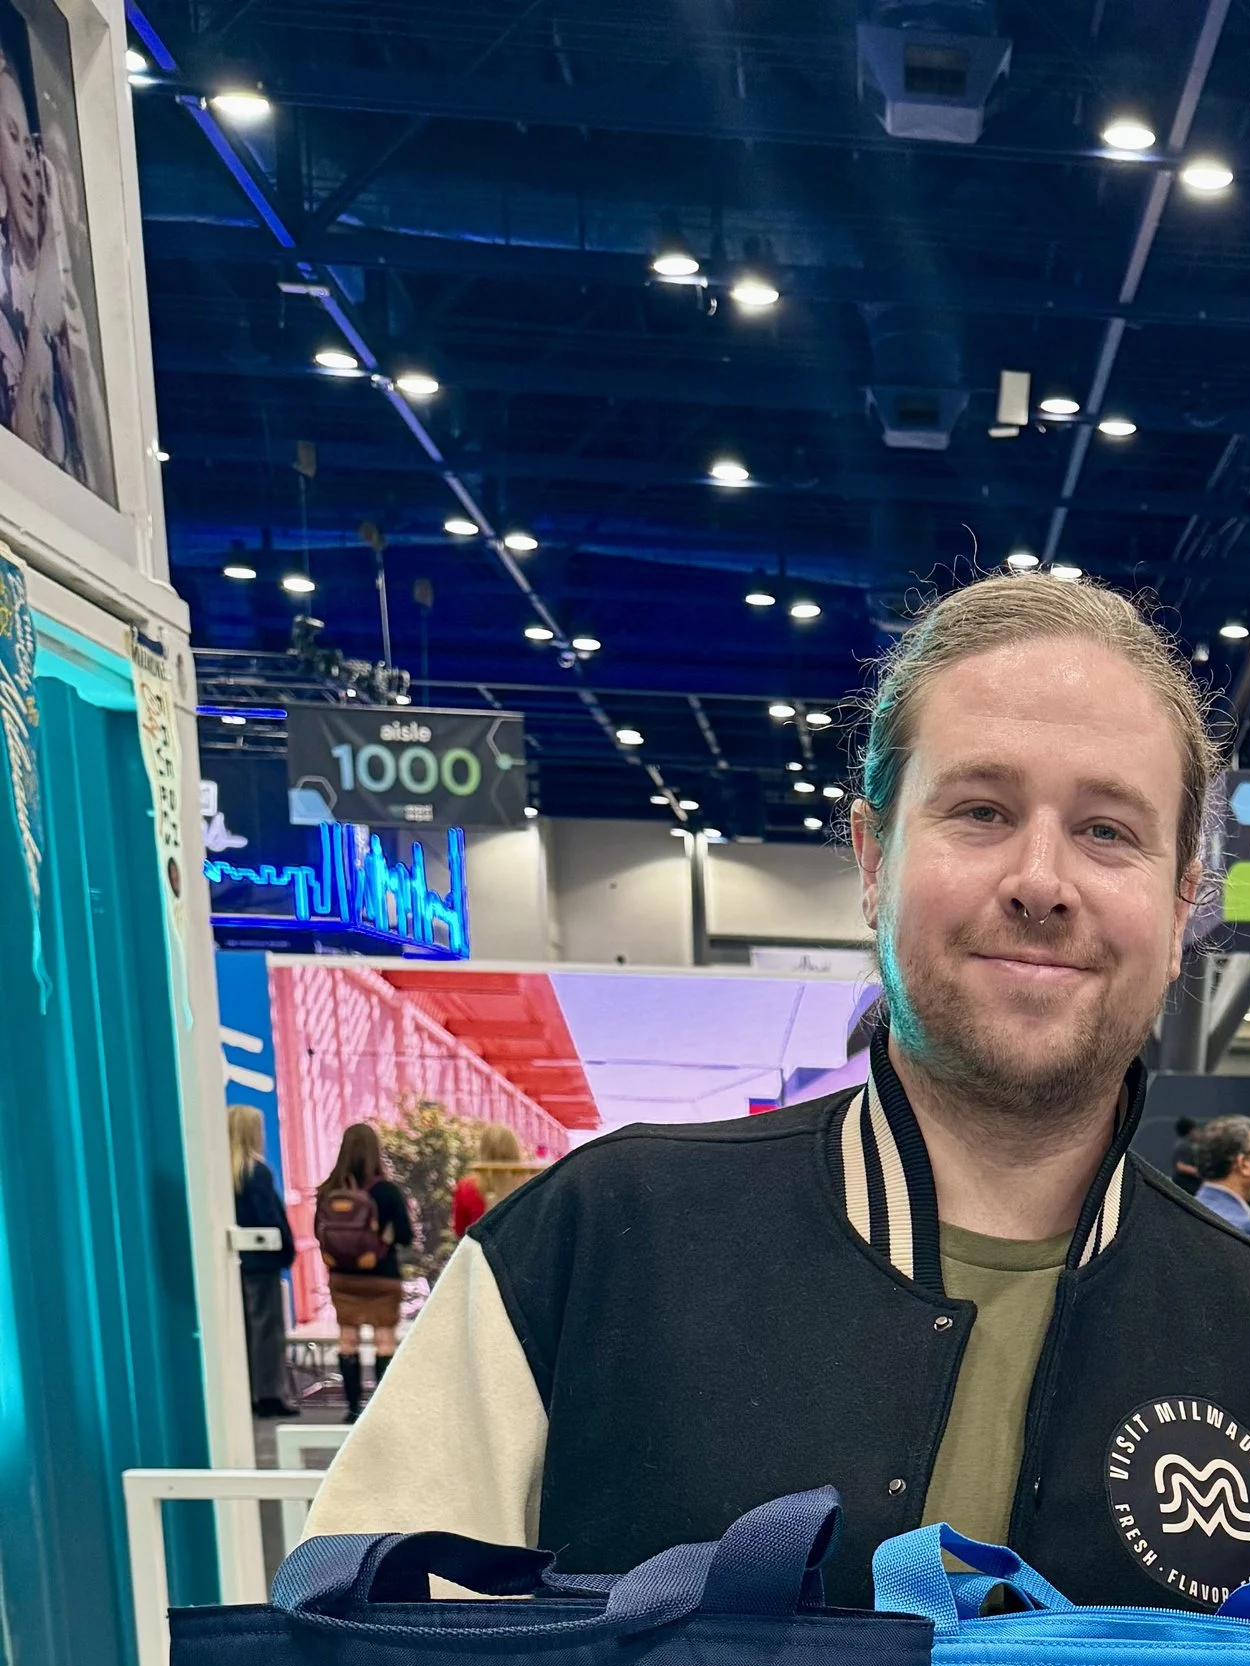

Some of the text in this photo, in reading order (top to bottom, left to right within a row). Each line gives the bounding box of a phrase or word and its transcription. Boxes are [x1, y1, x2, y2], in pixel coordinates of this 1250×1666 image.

[379, 720, 433, 743] aisle
[331, 743, 482, 797] 1000
[1109, 1413, 1150, 1480] VISIT
[1115, 1503, 1158, 1566] FRESH
[1167, 1568, 1230, 1604] FLAVOR
